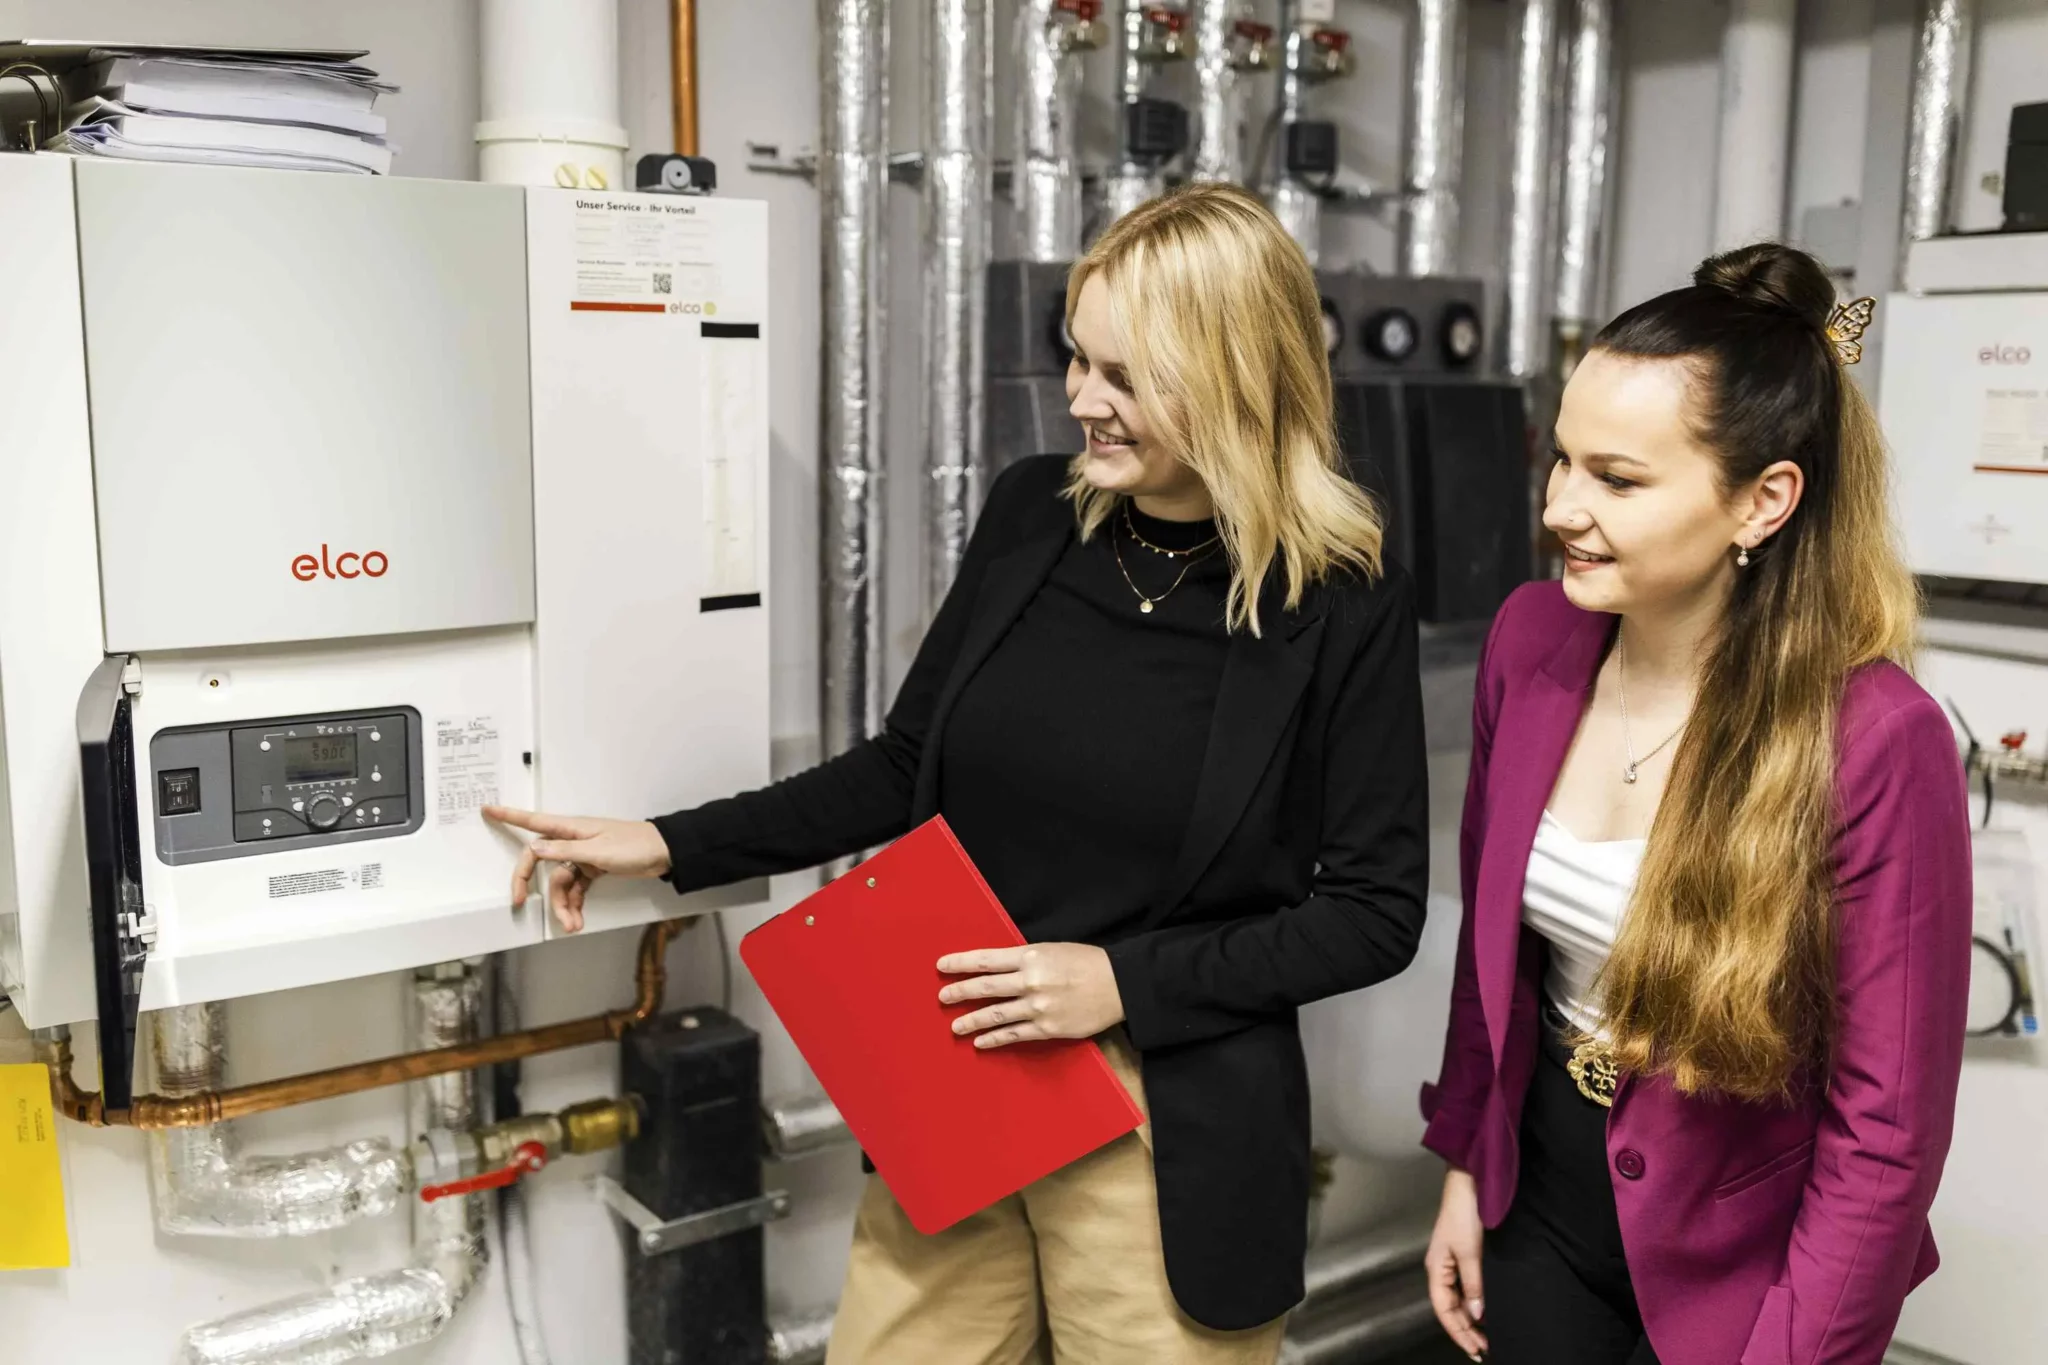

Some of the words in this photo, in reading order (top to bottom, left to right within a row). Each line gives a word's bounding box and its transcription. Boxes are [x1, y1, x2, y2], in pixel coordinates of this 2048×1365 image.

[576, 200, 604, 210] Unser
[606, 201, 642, 212] Service
[649, 204, 663, 213] Ihr
[665, 205, 696, 215] Vorteil
[669, 301, 702, 314] elco
[1978, 343, 2032, 365] elco
[291, 543, 389, 582] elco
